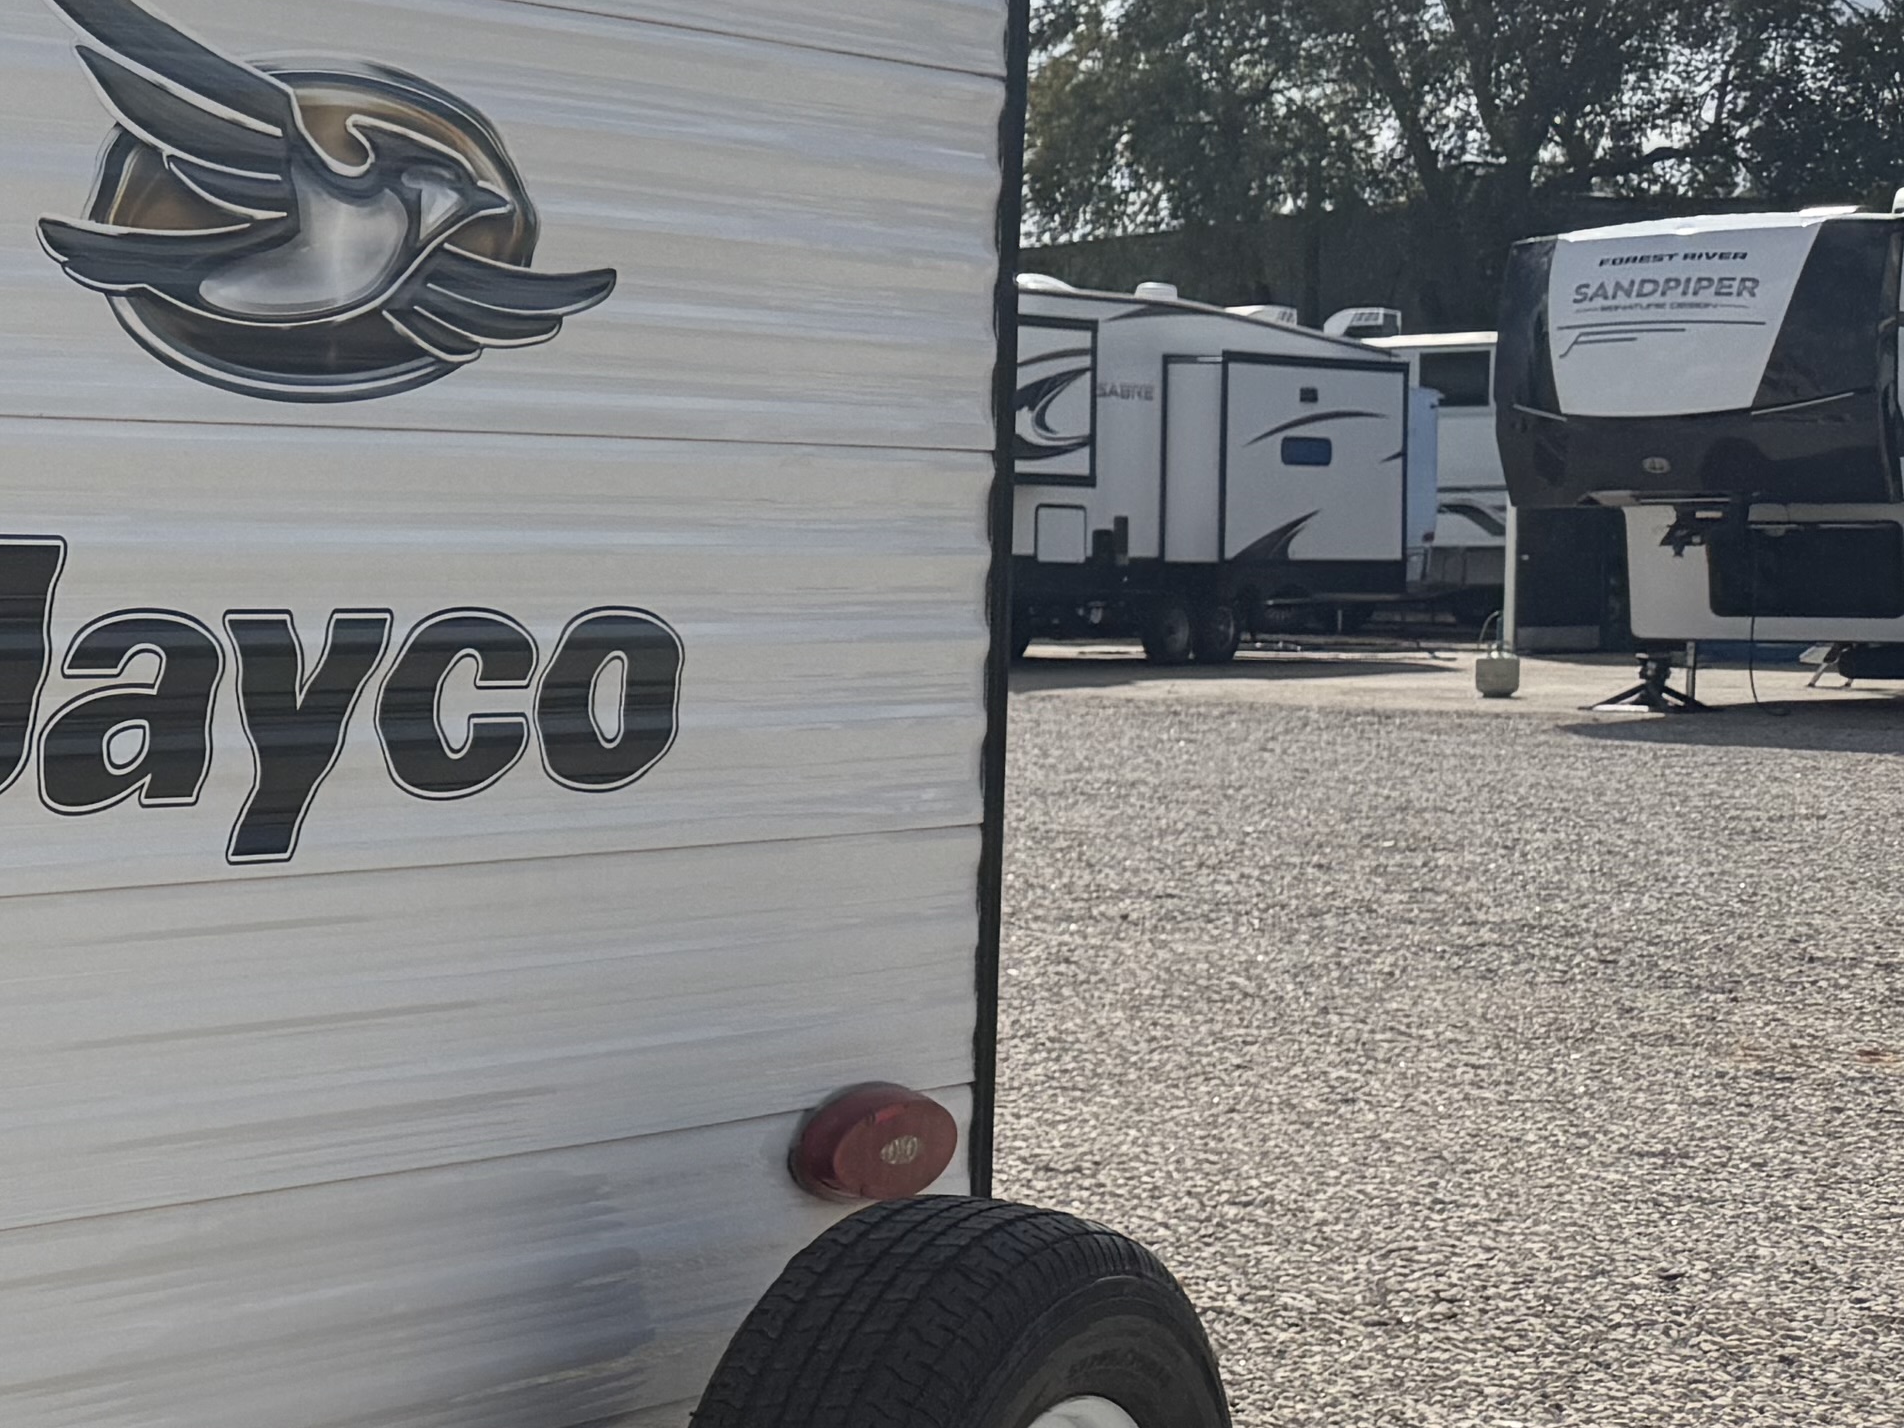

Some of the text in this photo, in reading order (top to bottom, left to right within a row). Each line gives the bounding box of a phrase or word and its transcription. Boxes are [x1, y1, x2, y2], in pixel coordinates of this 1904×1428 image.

[1598, 251, 1748, 267] FOREST RIVER
[1572, 276, 1760, 304] SANDPIPER
